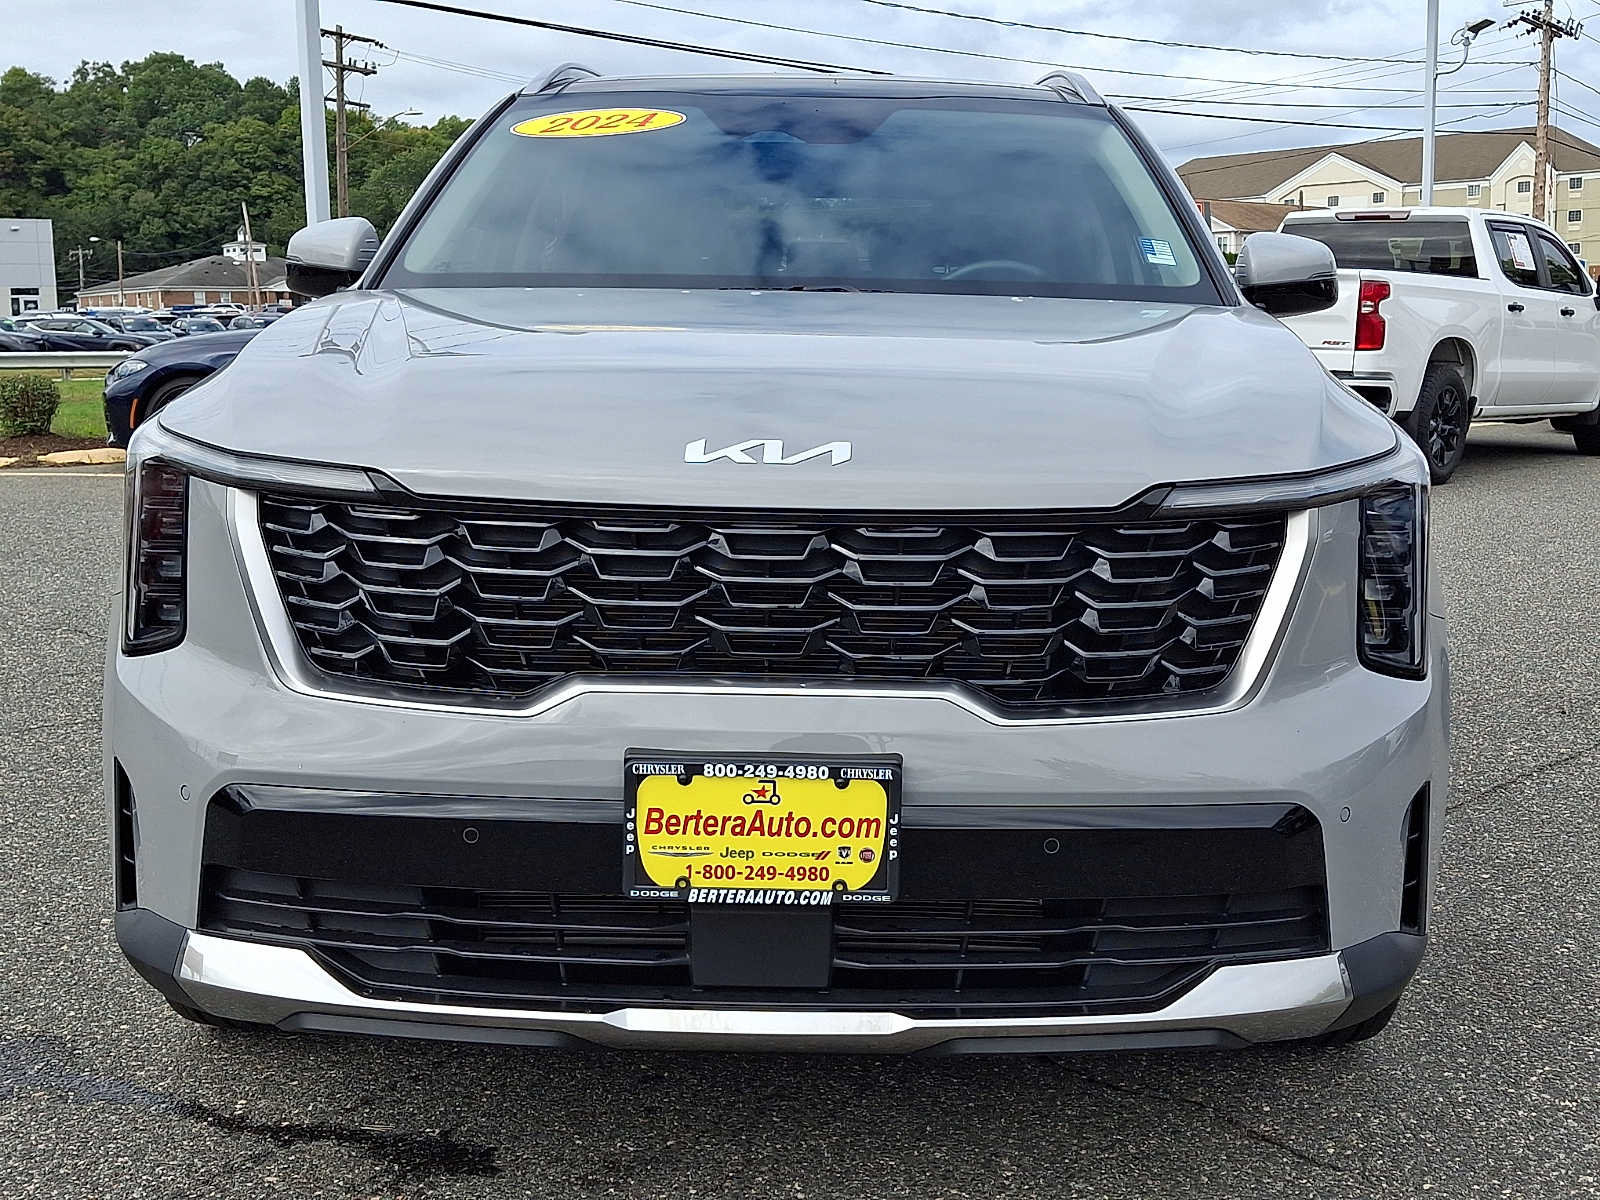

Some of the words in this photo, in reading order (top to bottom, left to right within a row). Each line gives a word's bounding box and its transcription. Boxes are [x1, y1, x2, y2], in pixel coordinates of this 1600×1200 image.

[539, 112, 658, 134] 2024
[632, 763, 685, 775] CHRYSLER
[703, 763, 830, 780] 800-249-4980
[840, 768, 893, 781] CHRYSLER
[625, 808, 636, 855] Jeep
[643, 807, 881, 839] BerteraAuto.com
[889, 814, 899, 861] Jeep
[719, 847, 755, 861] Jeep
[686, 864, 830, 882] 1-800-249-4980
[630, 889, 679, 898] DODGE
[688, 888, 833, 906] BERTERAAUTO.COM
[843, 894, 891, 902] DODGE
